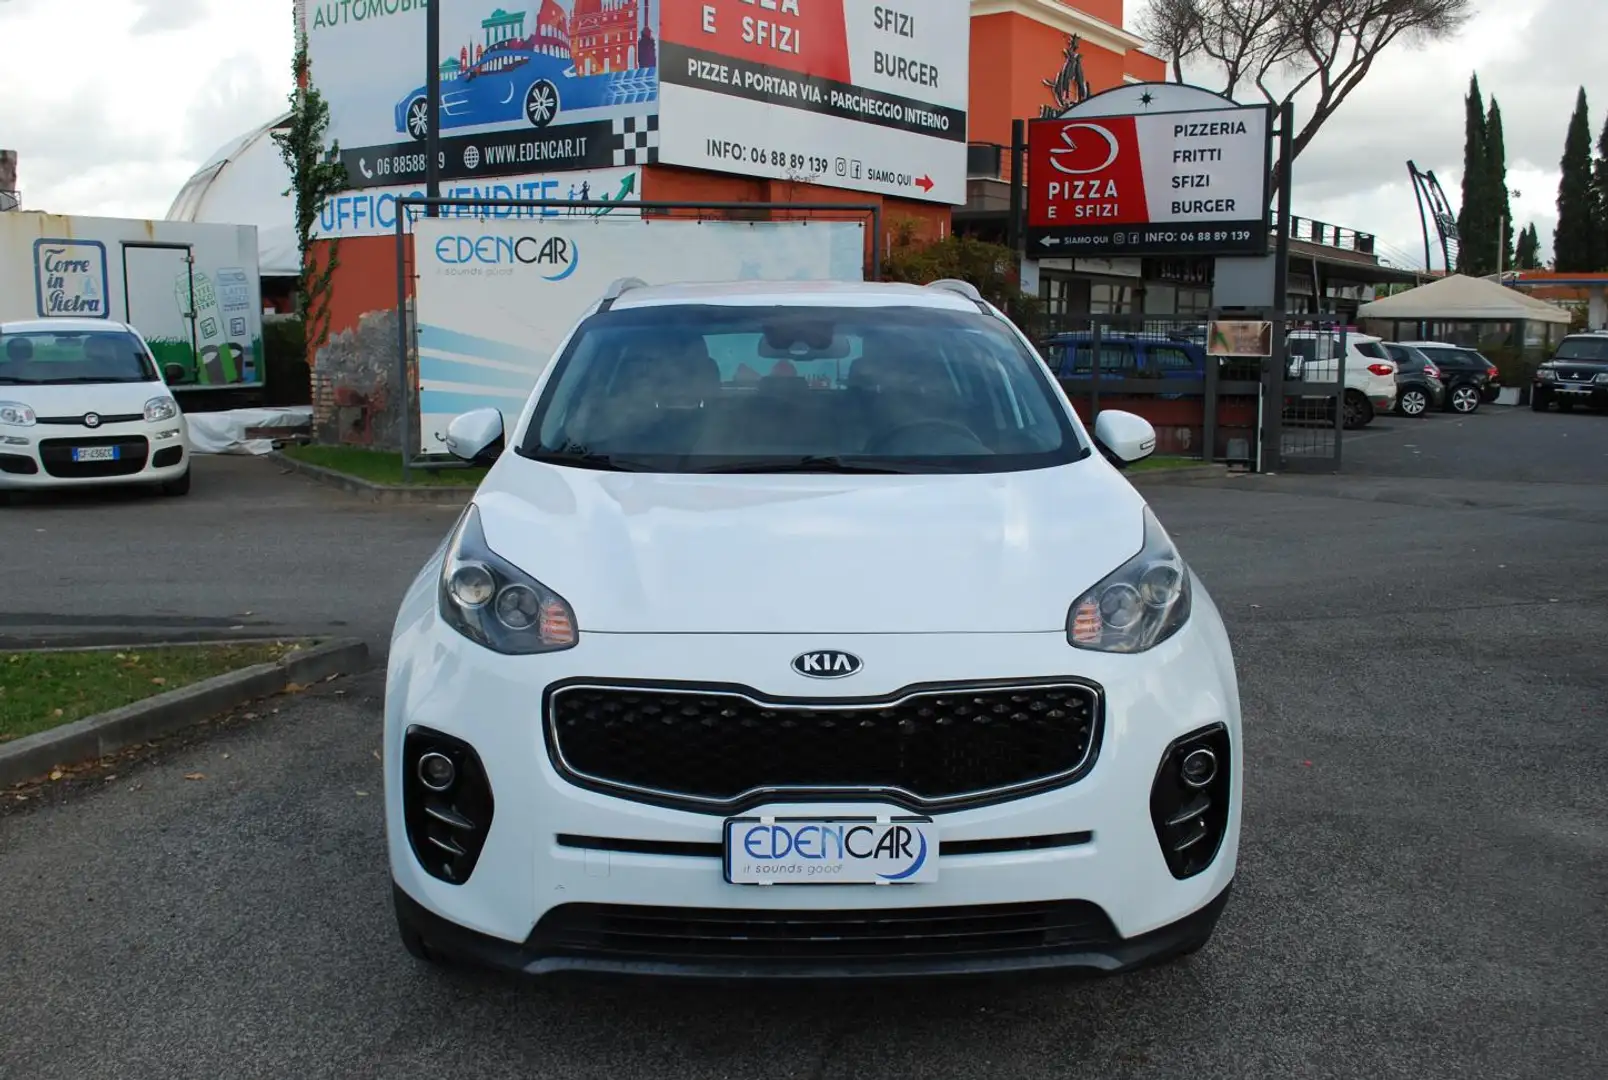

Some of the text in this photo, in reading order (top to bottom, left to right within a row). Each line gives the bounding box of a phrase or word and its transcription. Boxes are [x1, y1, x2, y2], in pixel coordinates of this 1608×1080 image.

[702, 5, 717, 34] E
[741, 15, 800, 55] SFIZI
[873, 6, 914, 39] SFIZI
[873, 51, 939, 88] BURGER
[687, 58, 949, 131] PIZZE A PORTAR VIA PARCHEGGIO INTERNO
[1174, 121, 1247, 138] PIZZERIA
[484, 137, 588, 165] WWW.EDENCAR.IT
[706, 139, 828, 173] INFO: 06 88 89 139
[1173, 148, 1221, 163] FRITTI
[377, 151, 445, 175] 06 885889
[867, 168, 911, 186] SIAMO QUI
[1171, 174, 1210, 189] SFIZI
[1048, 179, 1118, 200] PIZZA
[1048, 203, 1119, 218] E SFIZI
[1171, 199, 1235, 214] BURGER
[1064, 236, 1108, 245] SIAMO QUI
[1145, 231, 1250, 242] INFO: 06 88 89 139
[45, 248, 89, 273] Torre
[435, 236, 569, 264] EDENCAR
[47, 273, 64, 289] in
[50, 289, 99, 312] Pietra
[803, 654, 852, 671] KIA
[744, 825, 913, 859] EDENCAR
[755, 863, 803, 873] sounds
